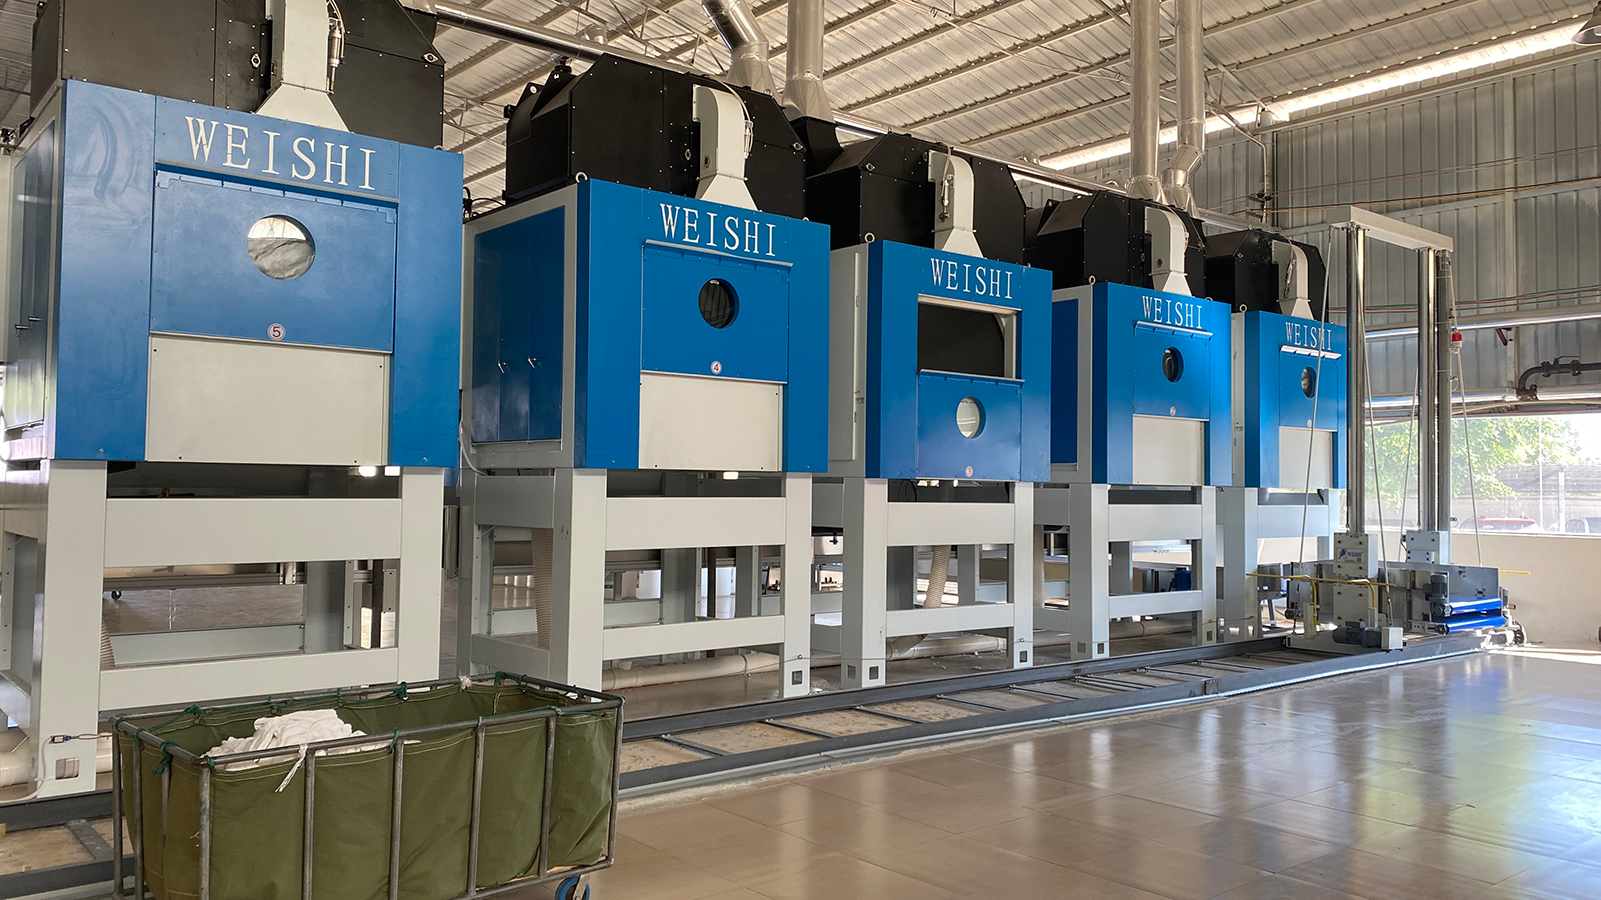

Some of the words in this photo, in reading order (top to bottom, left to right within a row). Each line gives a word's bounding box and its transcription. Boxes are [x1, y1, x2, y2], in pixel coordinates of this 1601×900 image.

[184, 116, 376, 190] WEISHI
[659, 203, 776, 257] WEISHI
[930, 257, 1013, 300] WEISHI
[1141, 295, 1202, 329] WEISHI
[272, 326, 281, 338] 5
[1285, 321, 1332, 351] WEISHI
